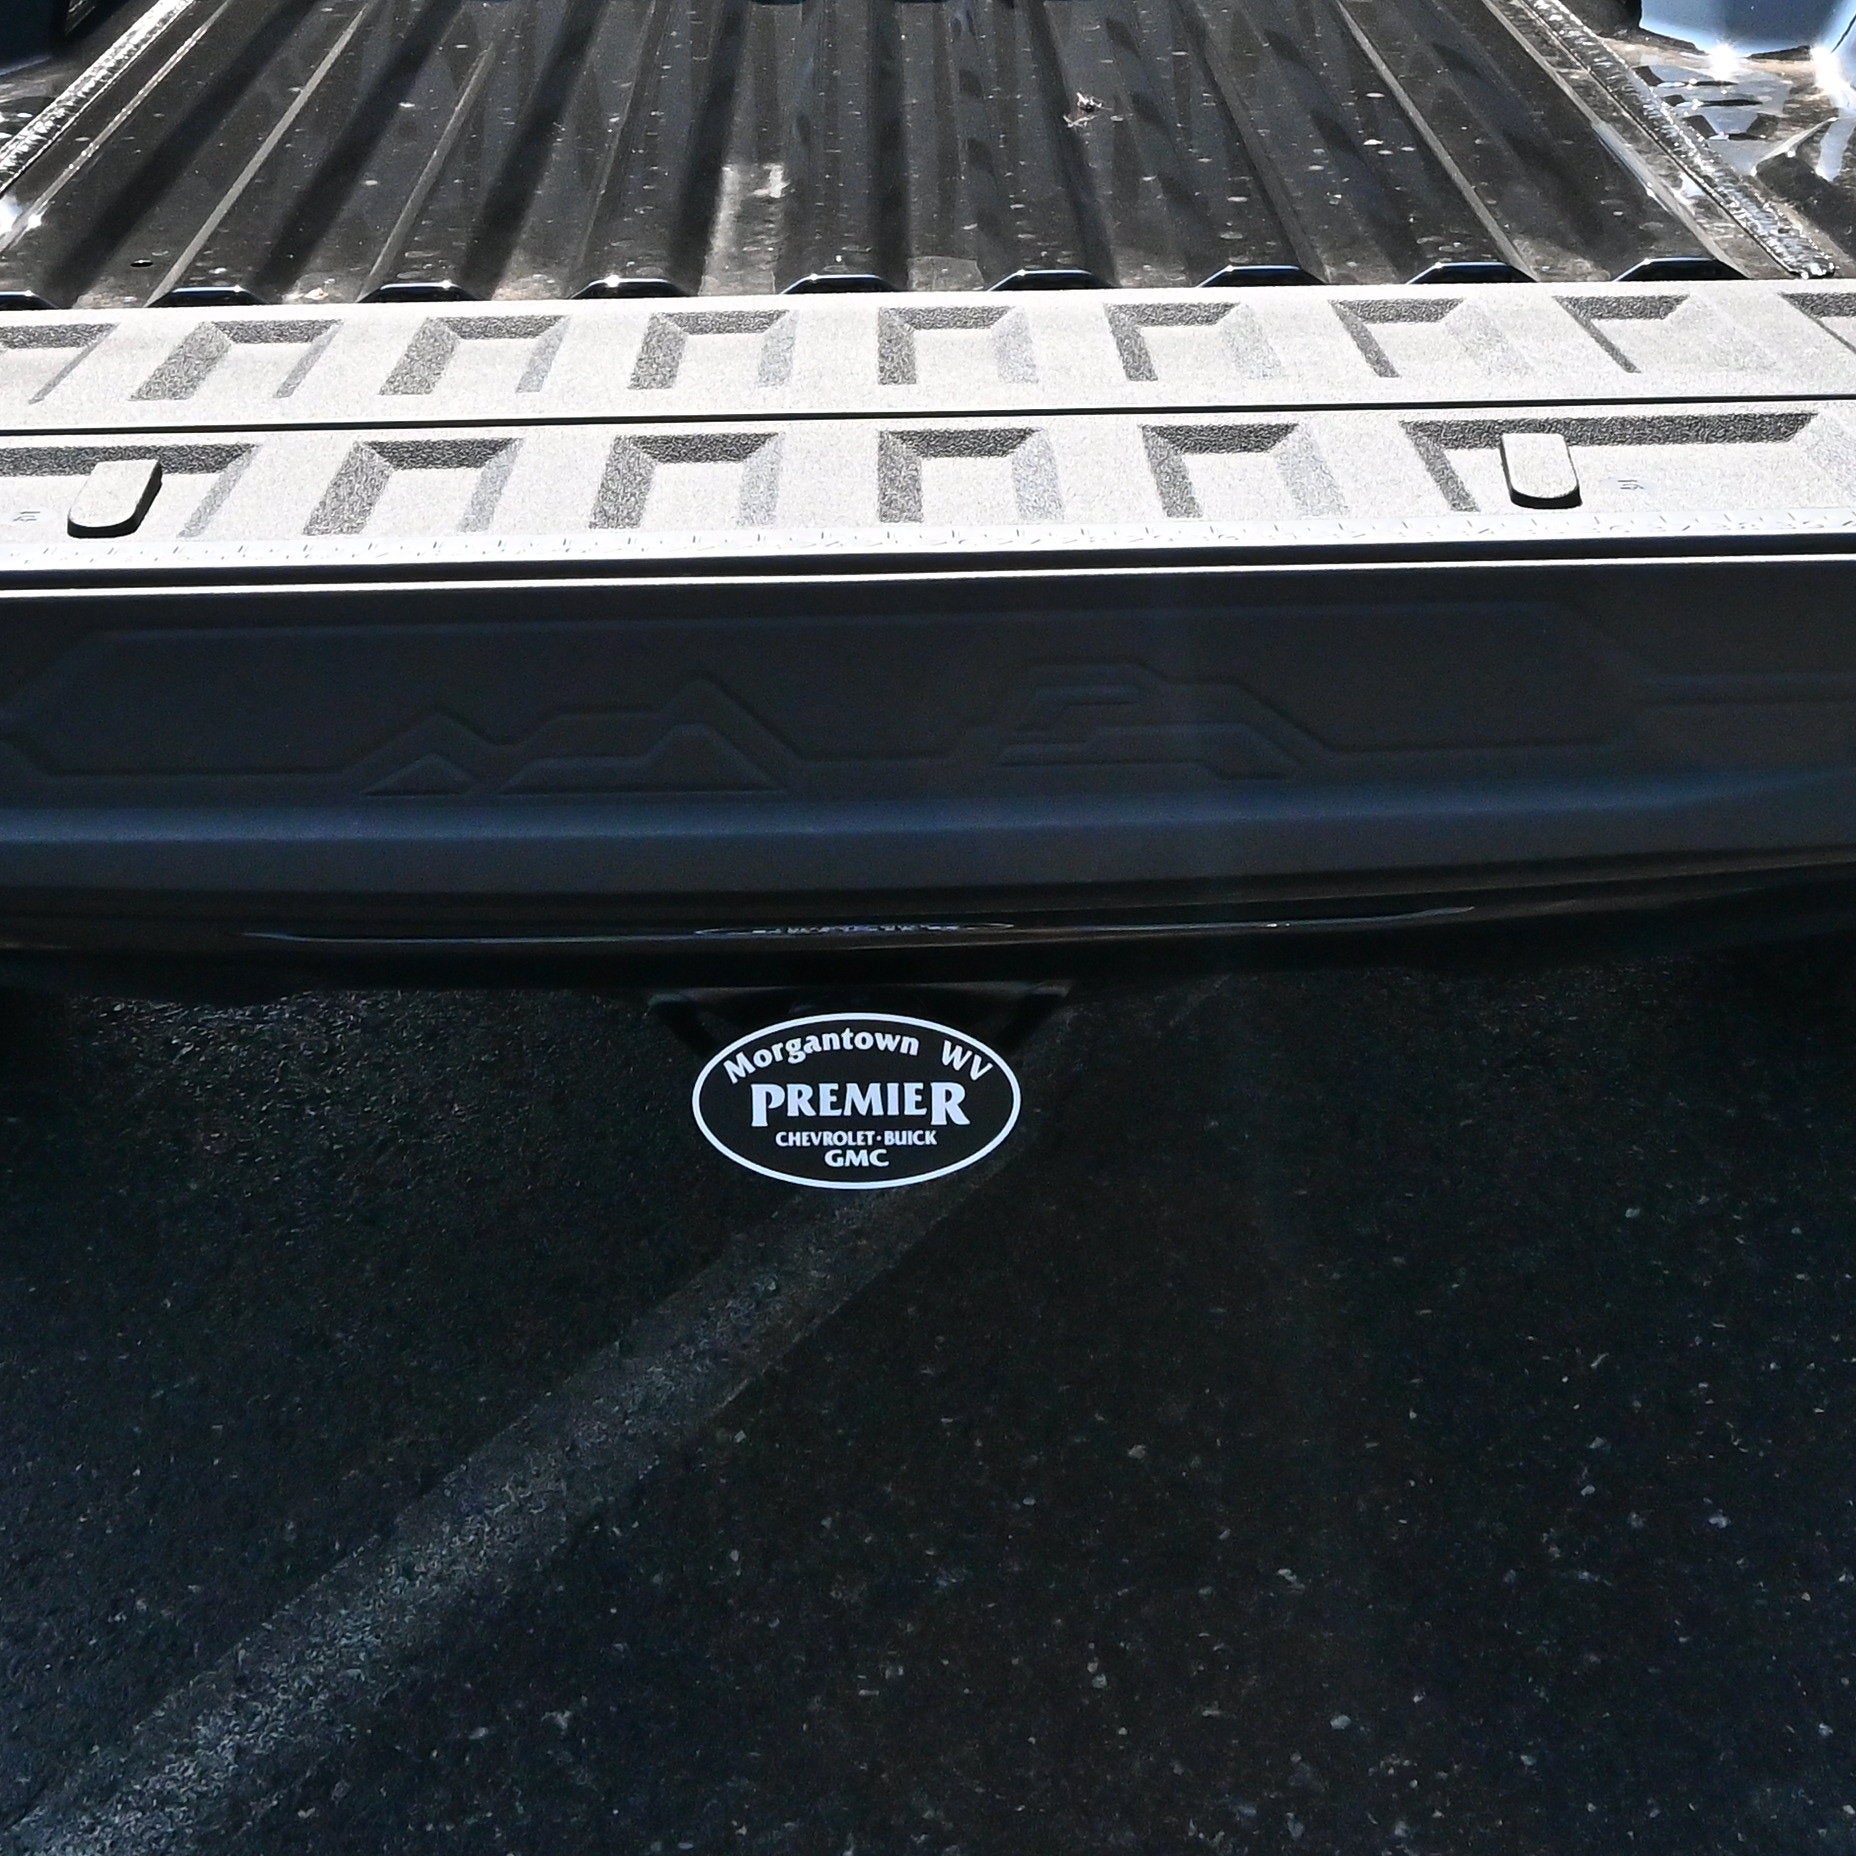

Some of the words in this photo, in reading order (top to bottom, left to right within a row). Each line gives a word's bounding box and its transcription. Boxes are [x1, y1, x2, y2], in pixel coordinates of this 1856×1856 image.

[723, 1027, 919, 1084] Morgantown
[941, 1040, 993, 1081] WV
[751, 1081, 970, 1127] PREMIER
[824, 1149, 890, 1168] GMC
